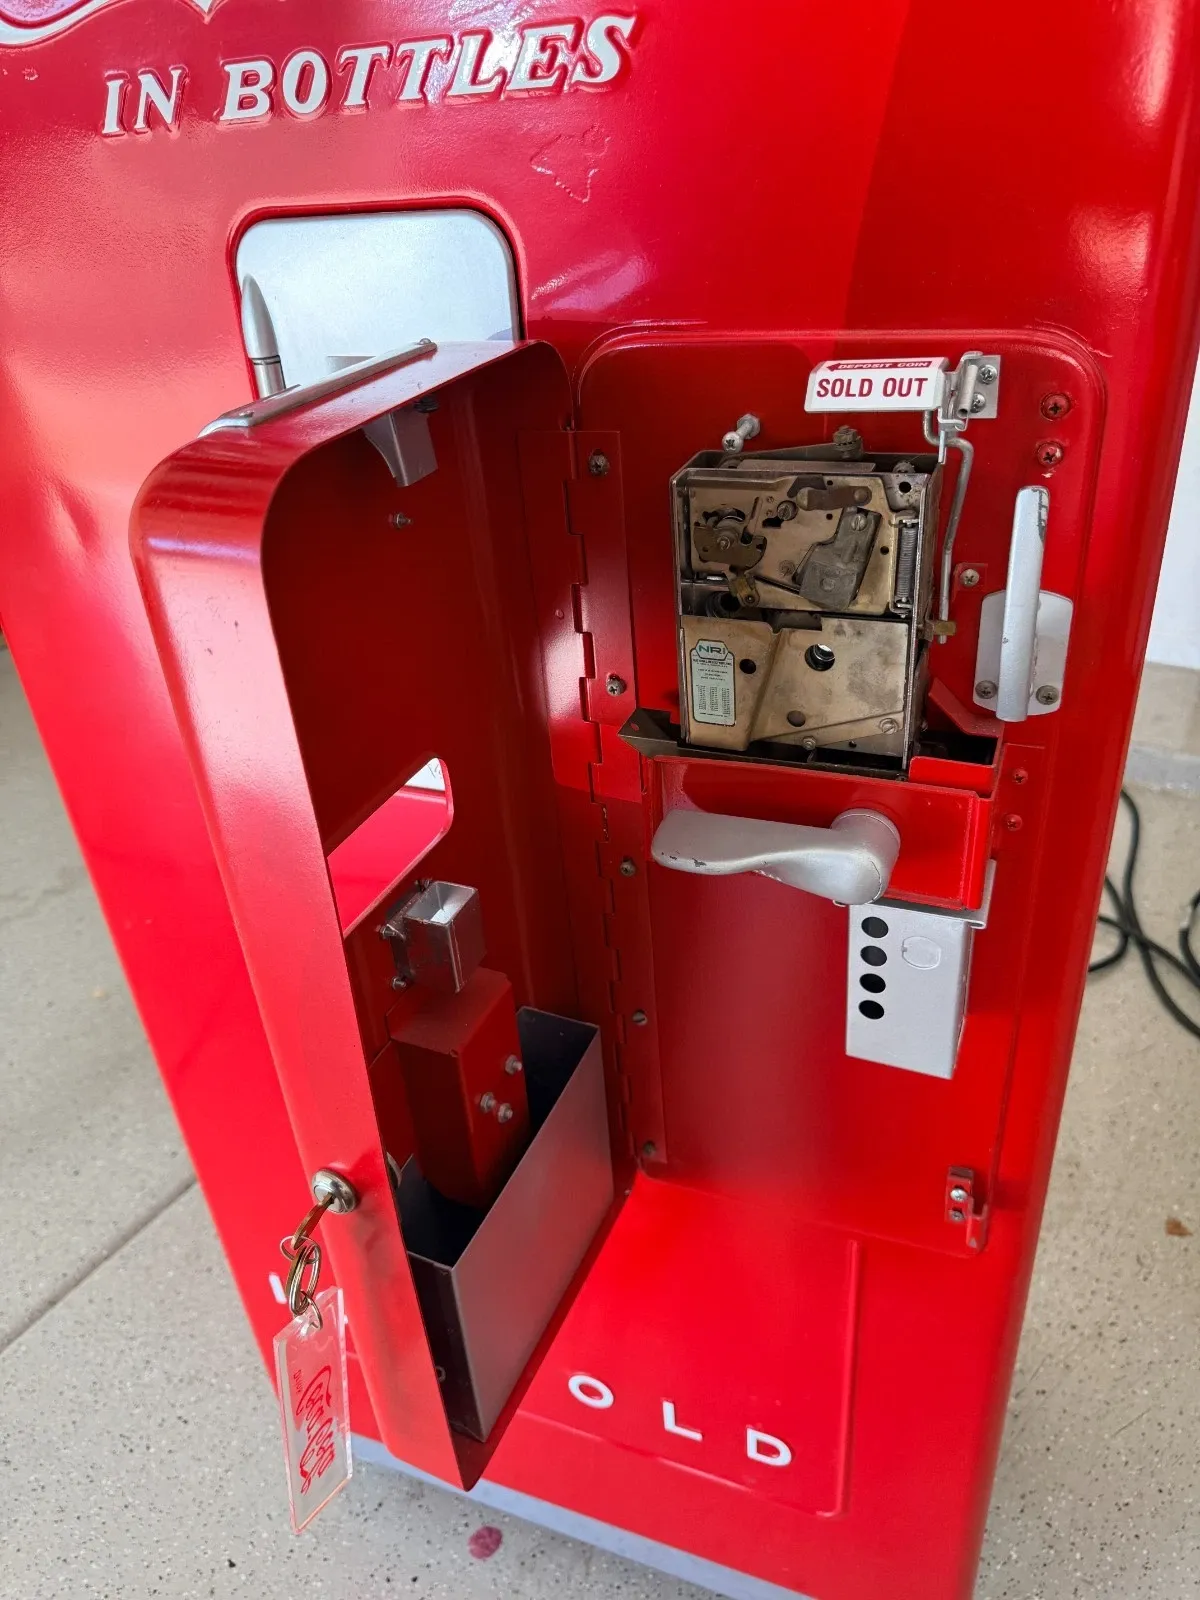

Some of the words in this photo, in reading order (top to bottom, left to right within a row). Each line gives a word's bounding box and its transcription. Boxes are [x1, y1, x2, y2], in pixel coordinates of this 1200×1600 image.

[101, 67, 182, 136] IN
[218, 15, 637, 124] BOTTLES
[816, 377, 874, 398] SOLD
[882, 377, 929, 398] OUT
[568, 1374, 792, 1467] OLD
